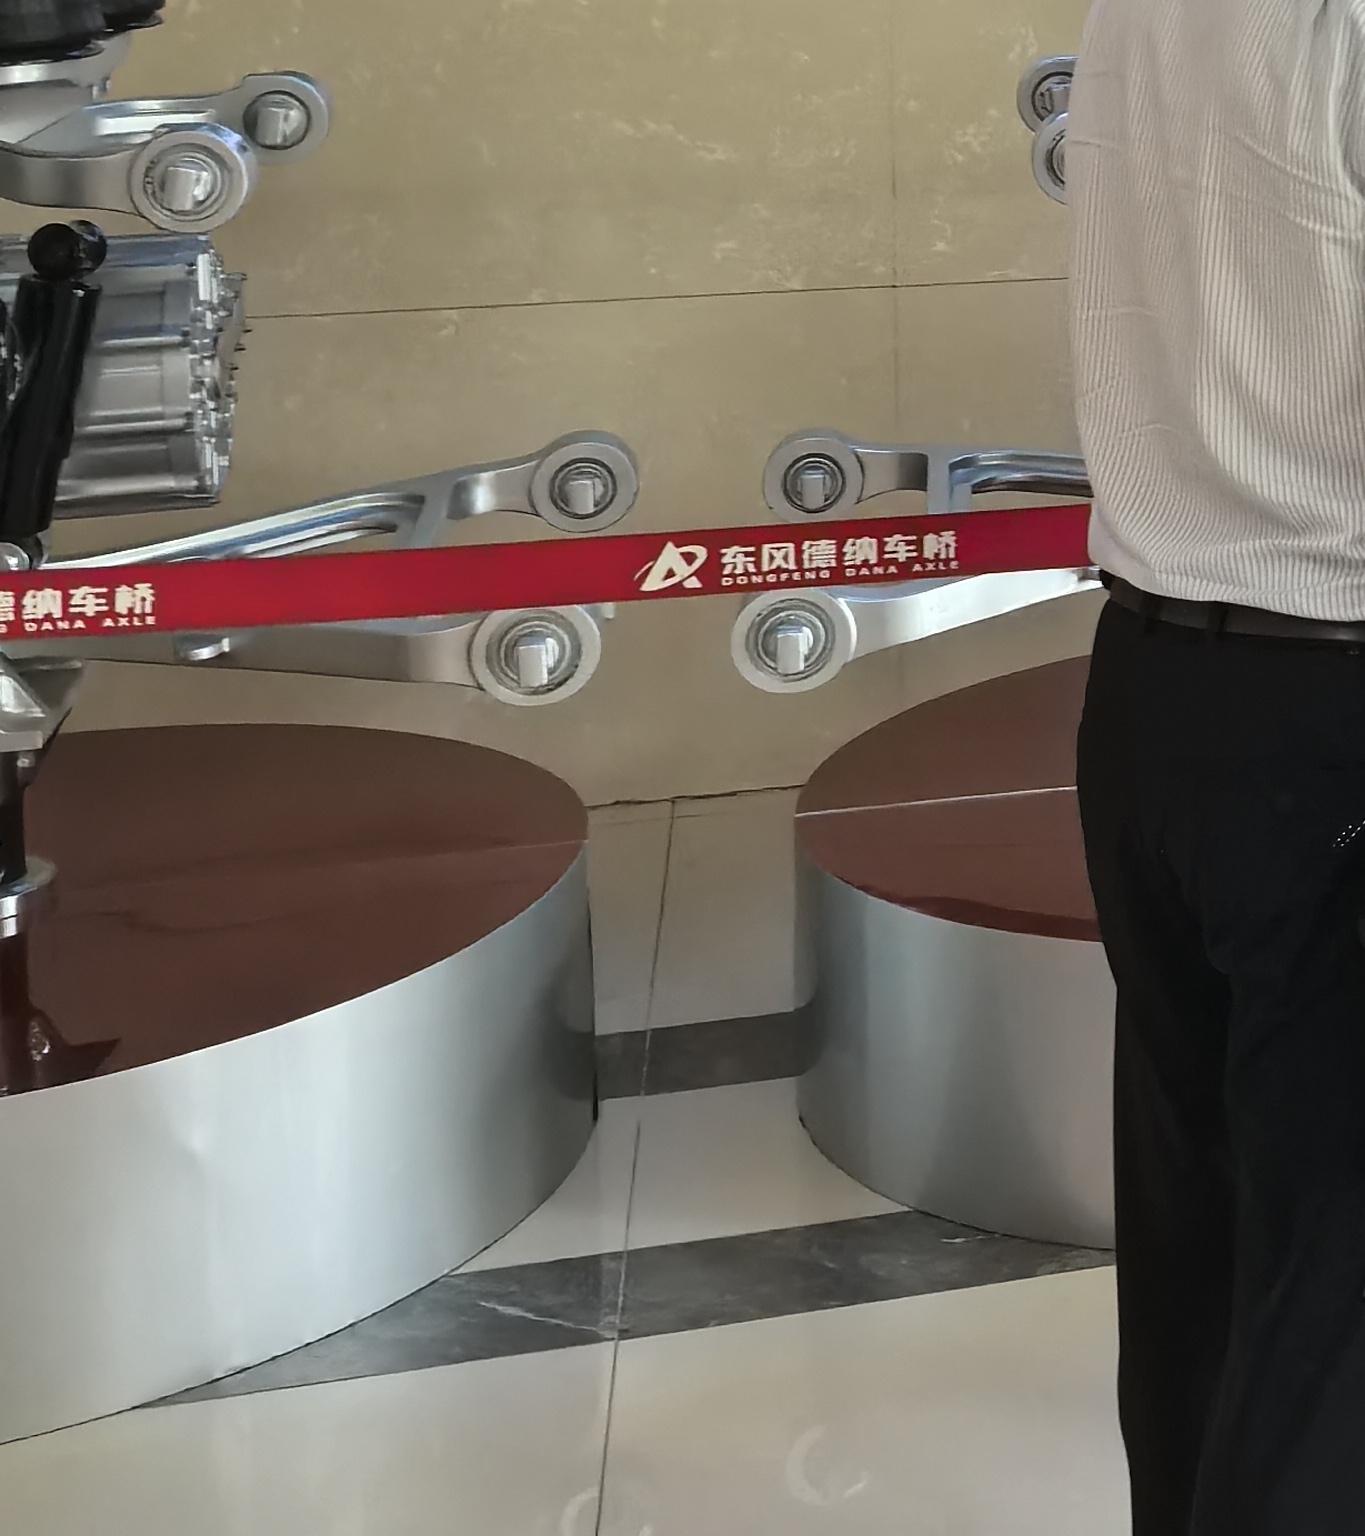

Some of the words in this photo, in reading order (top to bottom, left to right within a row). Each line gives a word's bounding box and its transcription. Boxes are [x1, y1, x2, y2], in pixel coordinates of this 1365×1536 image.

[720, 530, 957, 575] 东风德纳车桥
[721, 569, 831, 586] DONGFENG
[845, 565, 898, 577] DANA
[912, 560, 959, 572] AXLE
[24, 619, 86, 632] DANA
[102, 615, 156, 628] AXLE
